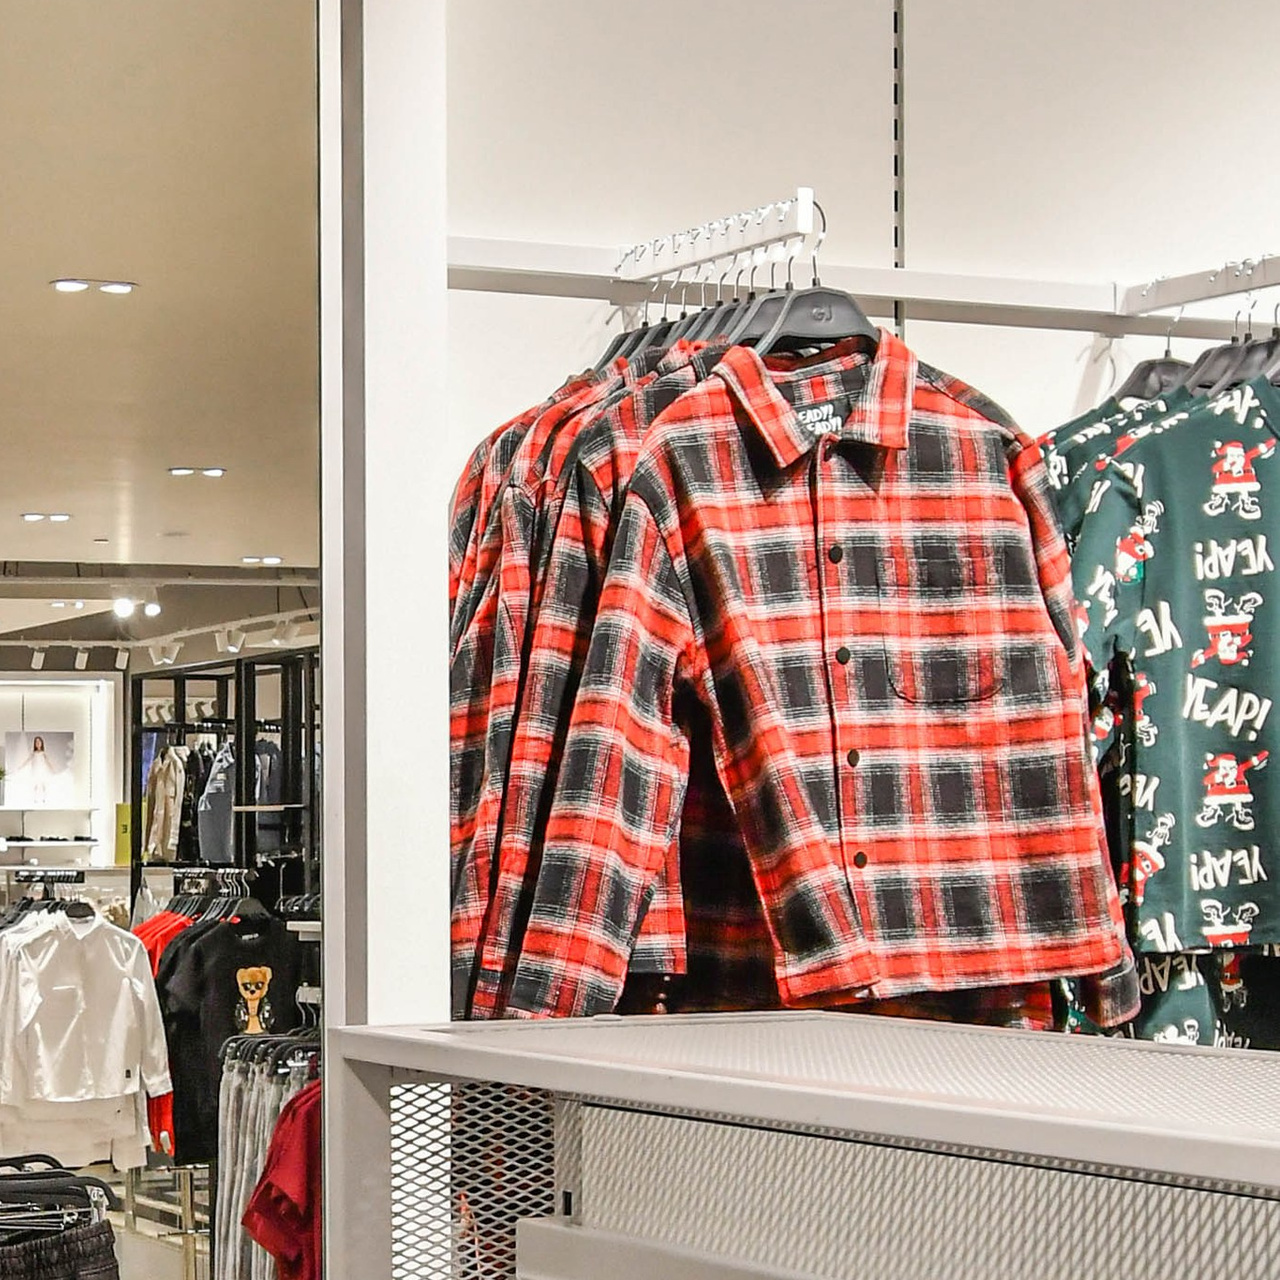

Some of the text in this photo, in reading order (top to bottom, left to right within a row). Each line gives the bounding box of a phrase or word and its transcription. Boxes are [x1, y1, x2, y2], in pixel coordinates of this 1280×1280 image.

[797, 403, 834, 424] EADY!
[1193, 533, 1275, 581] YEAP!
[1182, 672, 1272, 742] YEAP!
[1190, 845, 1268, 892] YEAP!
[1140, 953, 1205, 996] YEAP
